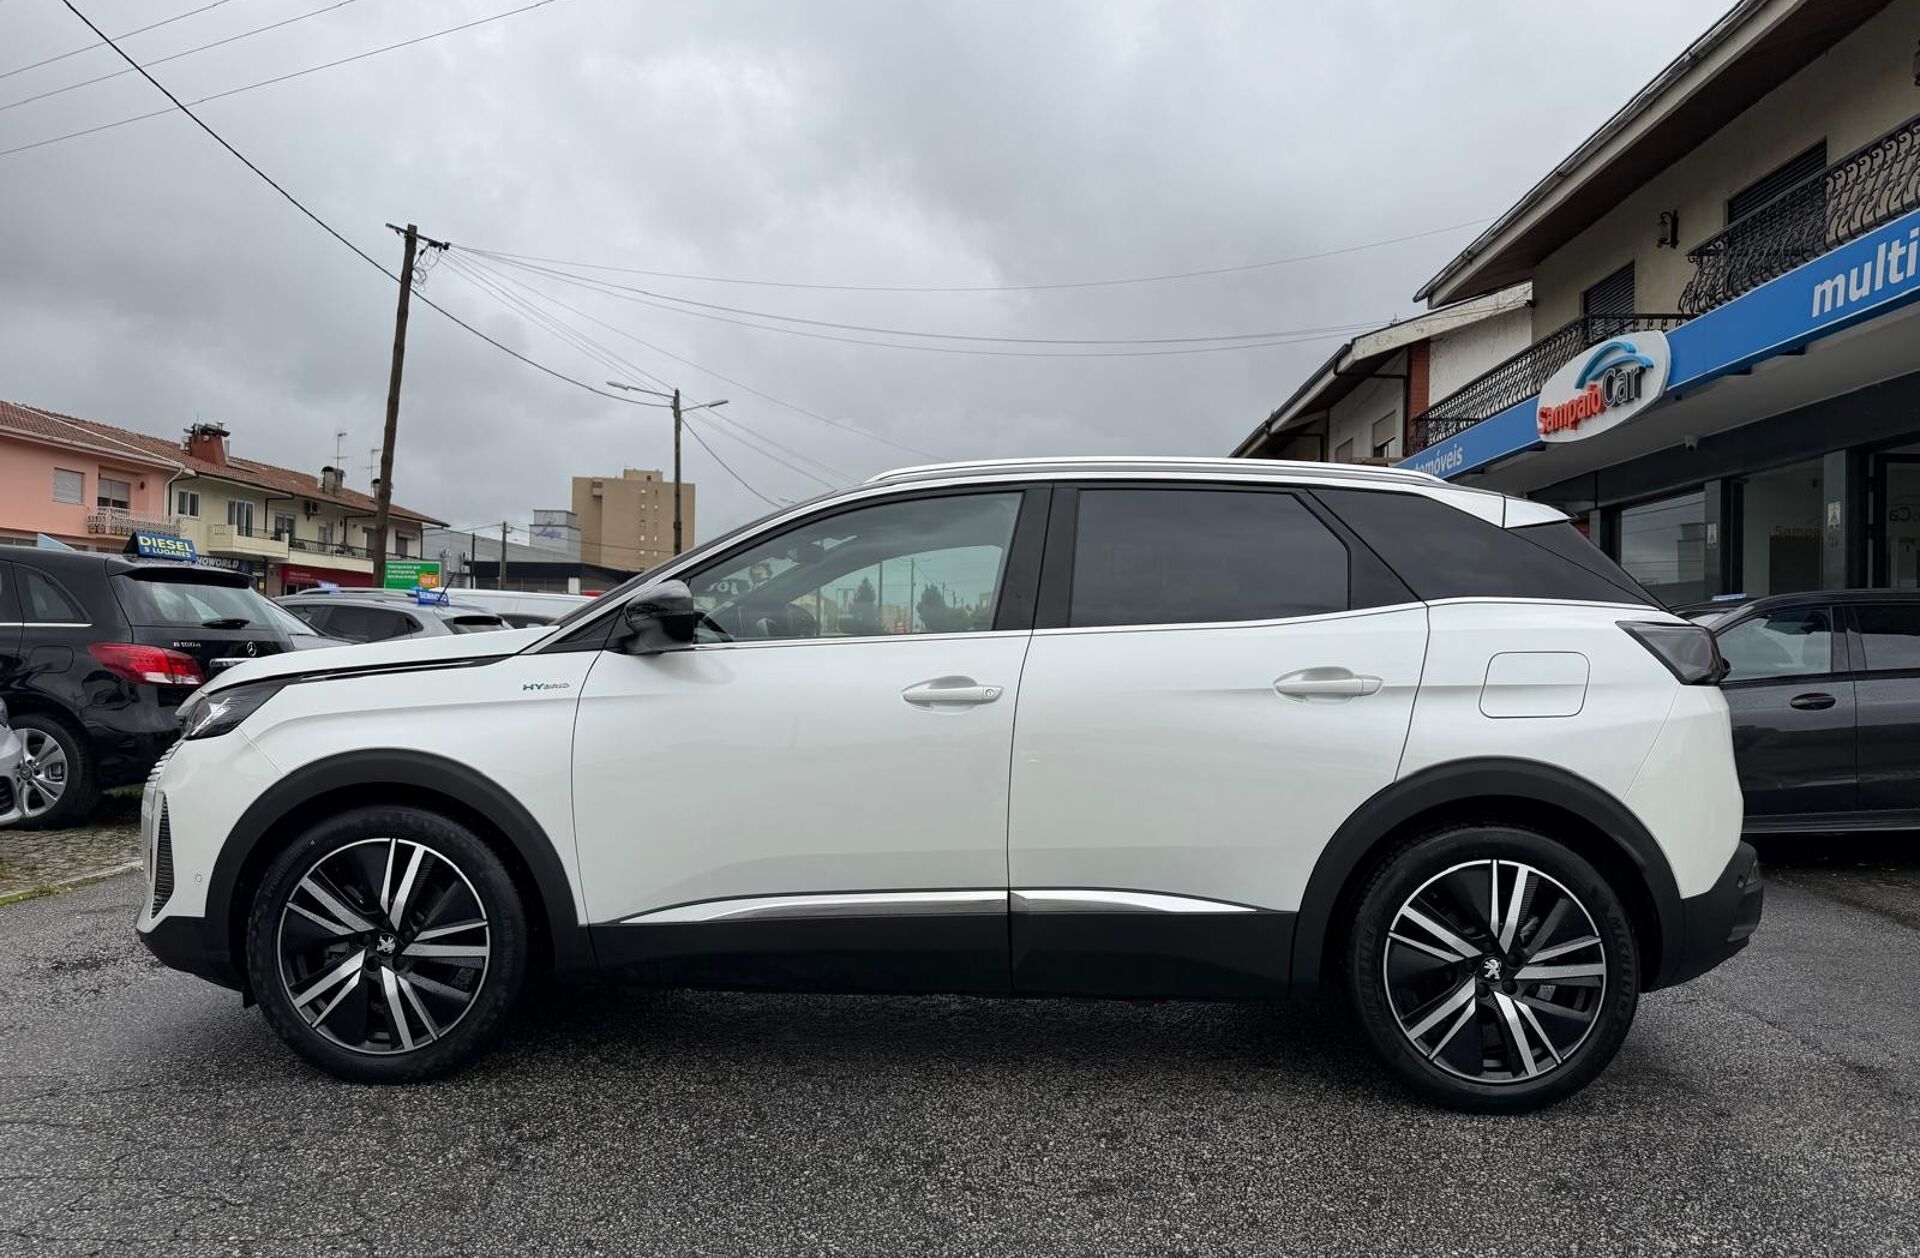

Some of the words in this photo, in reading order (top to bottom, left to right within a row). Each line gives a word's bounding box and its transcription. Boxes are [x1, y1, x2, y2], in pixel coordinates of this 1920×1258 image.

[1812, 227, 1920, 318] multi
[139, 536, 193, 552] DIESEL
[523, 682, 570, 690] HYBRID
